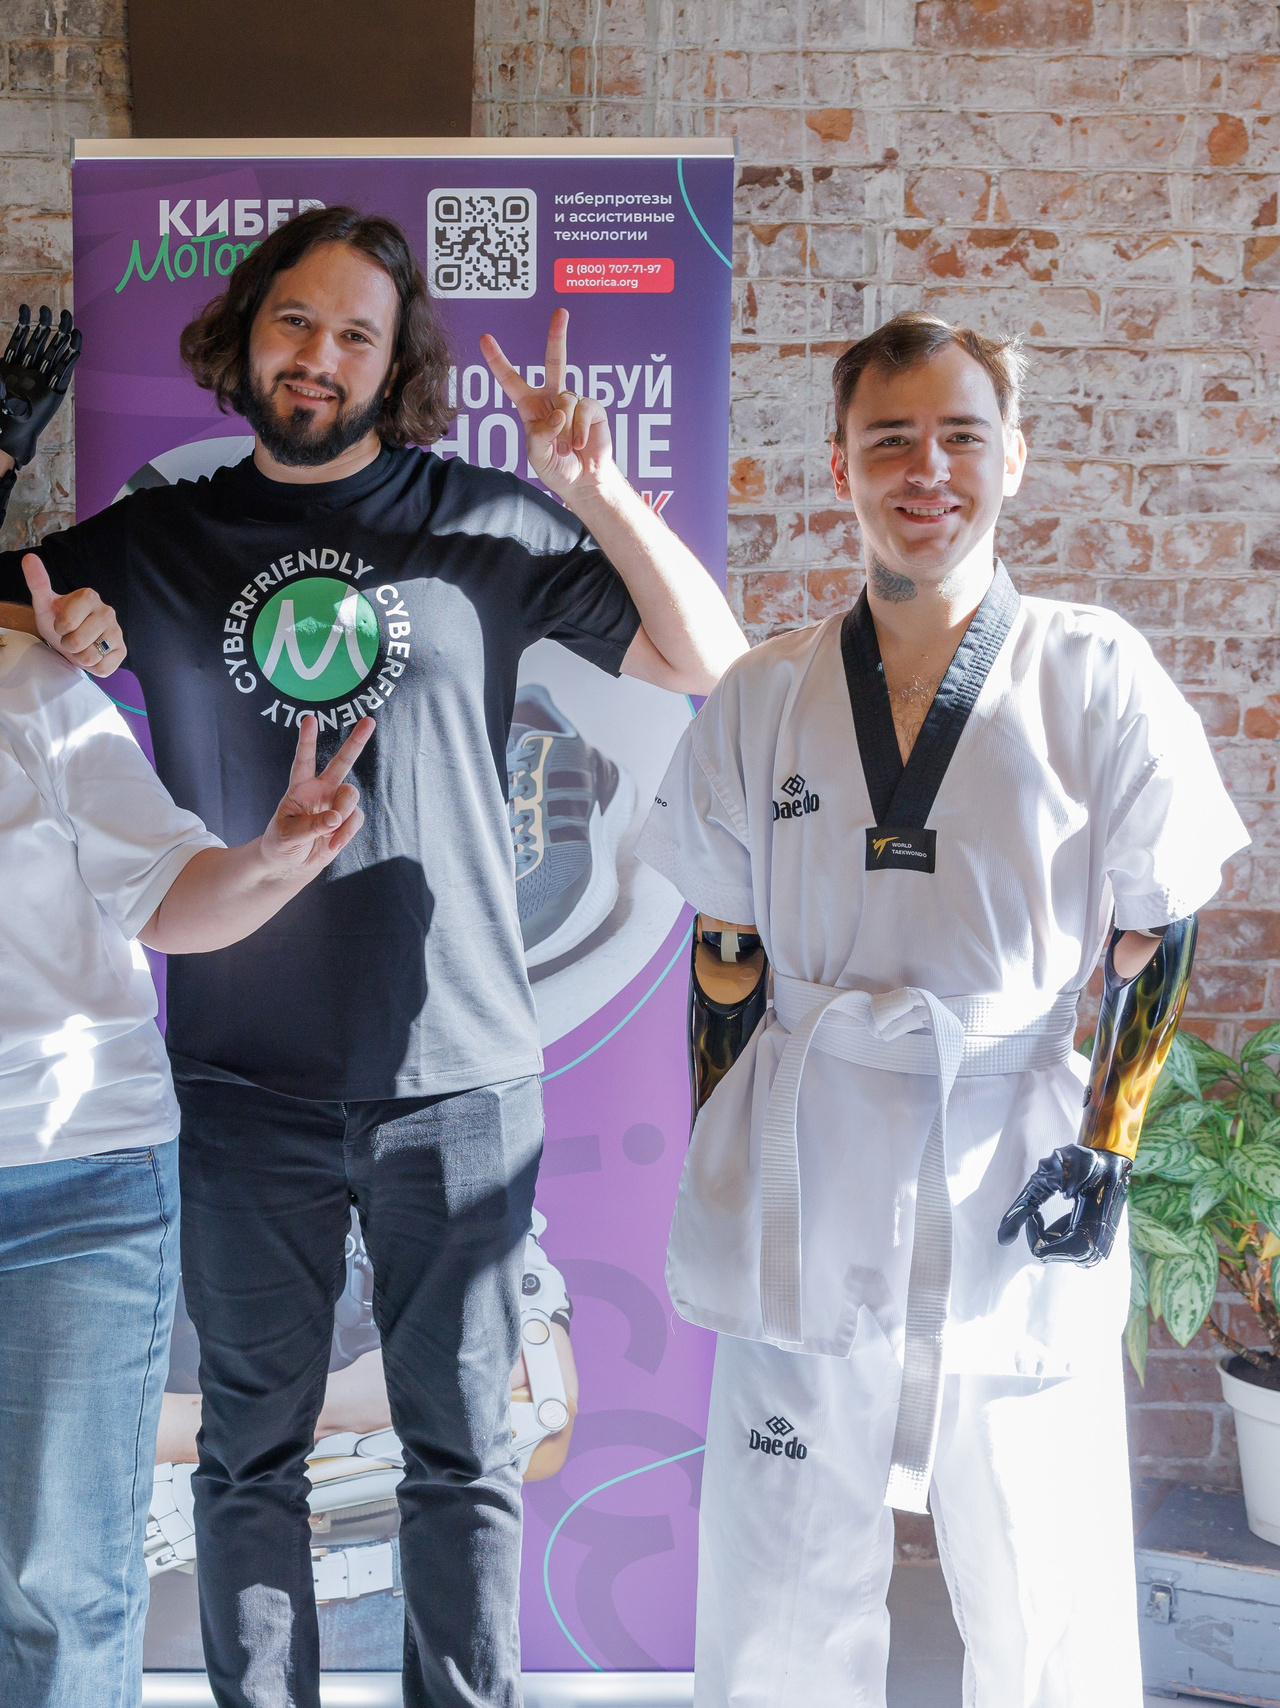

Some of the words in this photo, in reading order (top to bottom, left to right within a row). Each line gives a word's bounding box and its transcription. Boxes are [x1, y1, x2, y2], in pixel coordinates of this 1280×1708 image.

[554, 191, 673, 207] киберпротезы
[554, 212, 565, 222] и
[569, 212, 676, 223] ассистивные
[553, 230, 648, 241] технологии
[566, 264, 574, 274] 8
[576, 264, 606, 275] (800)
[608, 264, 662, 274] 707-71-97
[566, 277, 639, 289] motorica.org
[431, 413, 673, 479] НОЕ
[223, 548, 375, 694] CYBERFRIENDLY
[772, 789, 820, 822] Daedo
[891, 849, 928, 858] TAEKWONDO
[749, 1428, 808, 1460] Daedo
